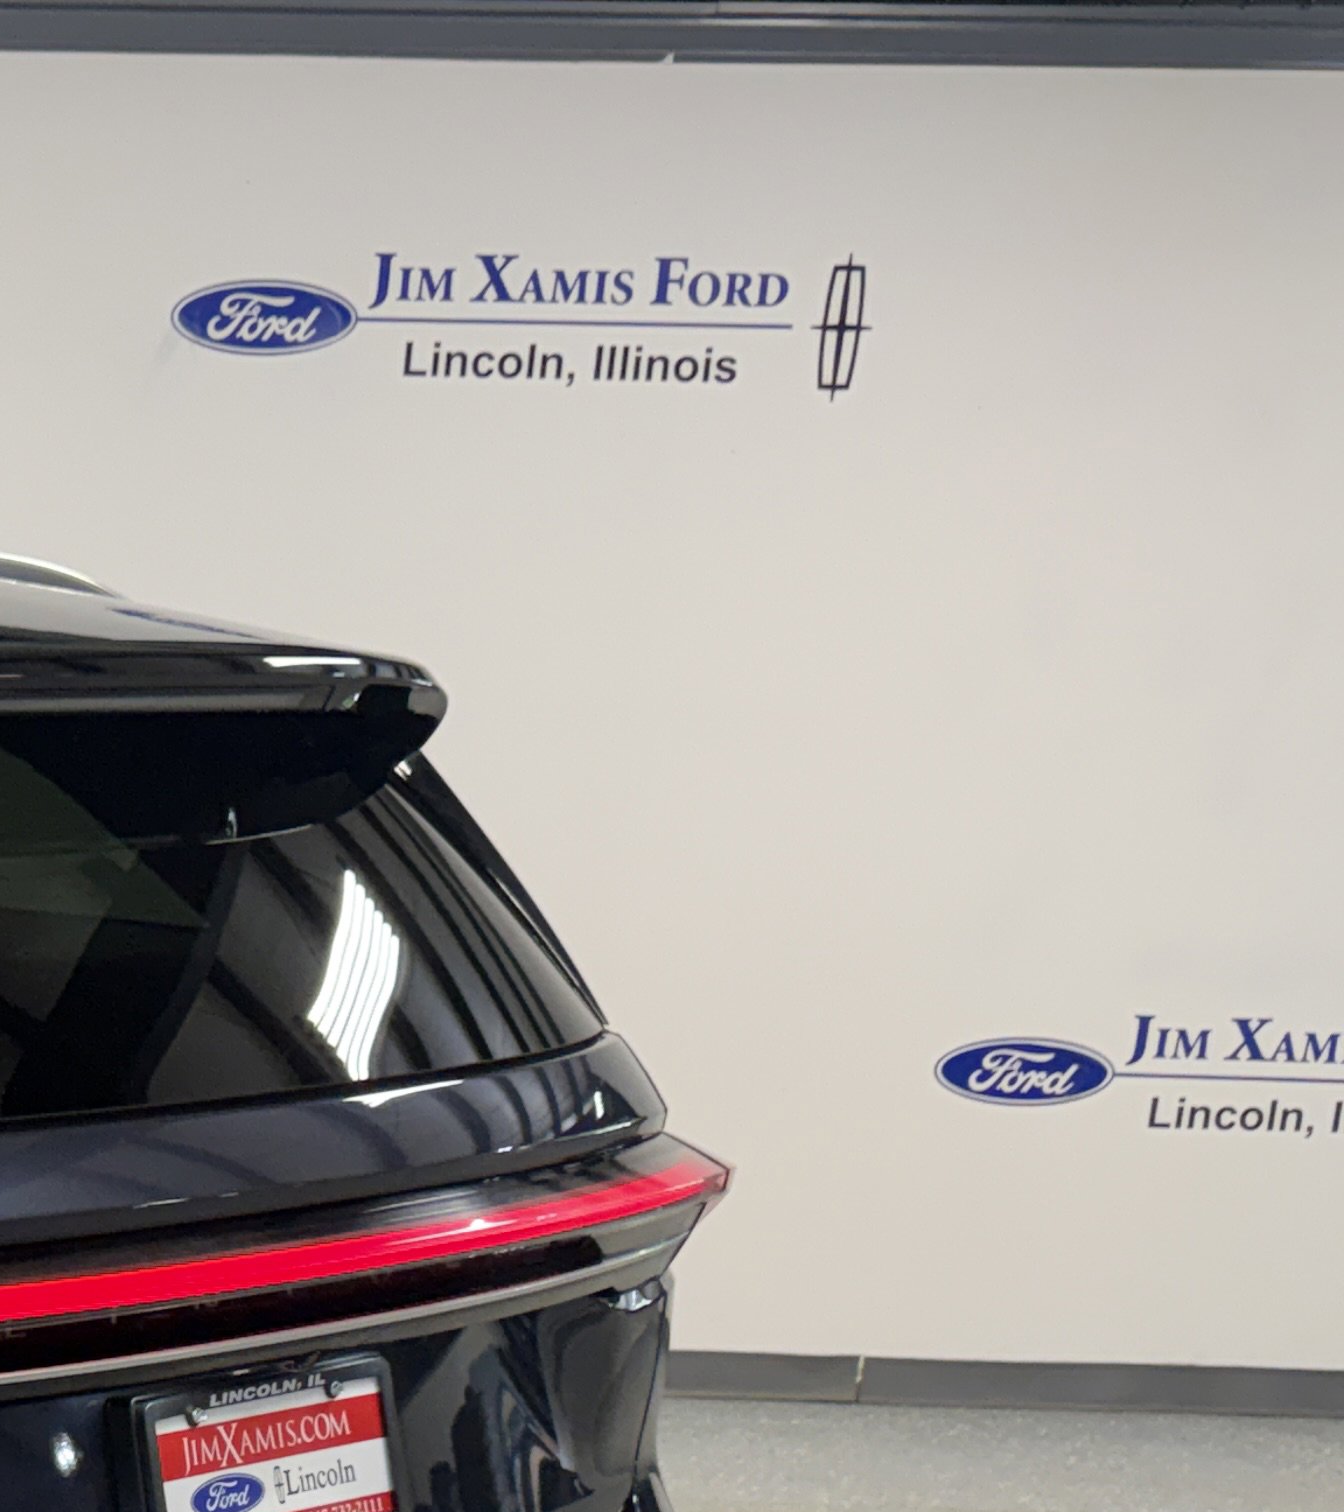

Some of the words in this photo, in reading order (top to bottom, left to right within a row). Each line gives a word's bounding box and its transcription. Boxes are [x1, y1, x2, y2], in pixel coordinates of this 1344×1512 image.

[368, 252, 456, 309] JIM
[470, 254, 634, 305] XAMIS
[650, 257, 789, 307] FORD
[207, 292, 321, 342] Ford
[403, 341, 575, 387] Lincoln,
[593, 345, 737, 384] Illinois
[1126, 1015, 1211, 1065] JIM
[1224, 1018, 1344, 1064] XAM
[968, 1048, 1079, 1095] Ford
[1147, 1096, 1314, 1138] Lincoln,
[209, 1378, 303, 1407] LINCOLN,
[307, 1374, 326, 1388] IL
[205, 1480, 250, 1512] Ford
[283, 1459, 357, 1496] Lincoln
